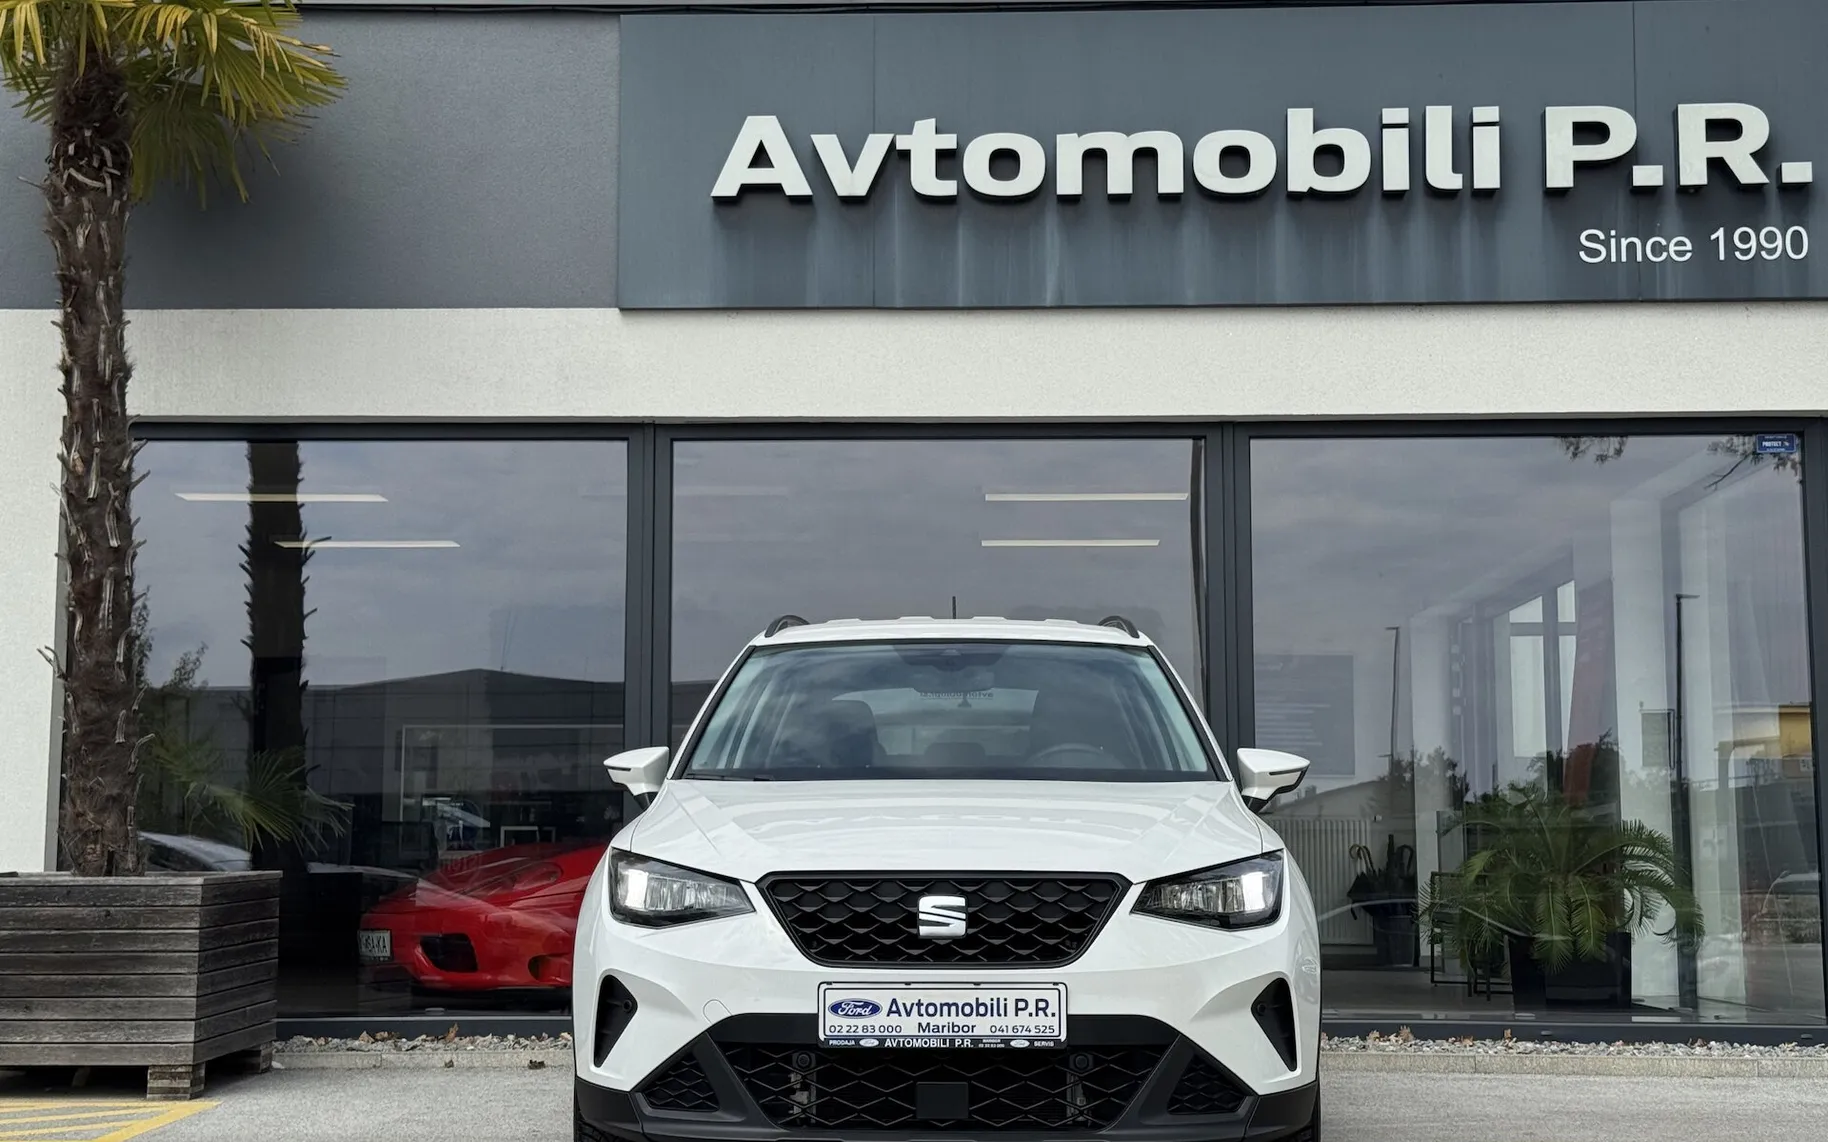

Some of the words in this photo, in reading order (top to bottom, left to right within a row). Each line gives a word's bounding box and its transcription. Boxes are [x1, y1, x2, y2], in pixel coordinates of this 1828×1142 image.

[711, 105, 1501, 197] Avtomobili
[1545, 102, 1813, 188] P.R.
[1578, 228, 1693, 264] Since
[1709, 225, 1809, 261] 1990
[838, 1001, 873, 1016] Ford
[886, 997, 1008, 1017] Avtomobili
[1014, 998, 1056, 1017] P.R.
[828, 1024, 844, 1034] 02
[845, 1024, 859, 1034] 22
[861, 1024, 876, 1034] 83
[878, 1024, 902, 1034] 000
[917, 1021, 976, 1034] Maribor
[989, 1024, 1009, 1034] 041
[1012, 1024, 1031, 1034] 674
[1034, 1024, 1055, 1034] 525
[884, 1038, 950, 1048] AVTOMOBILI
[954, 1038, 974, 1048] P.R.
